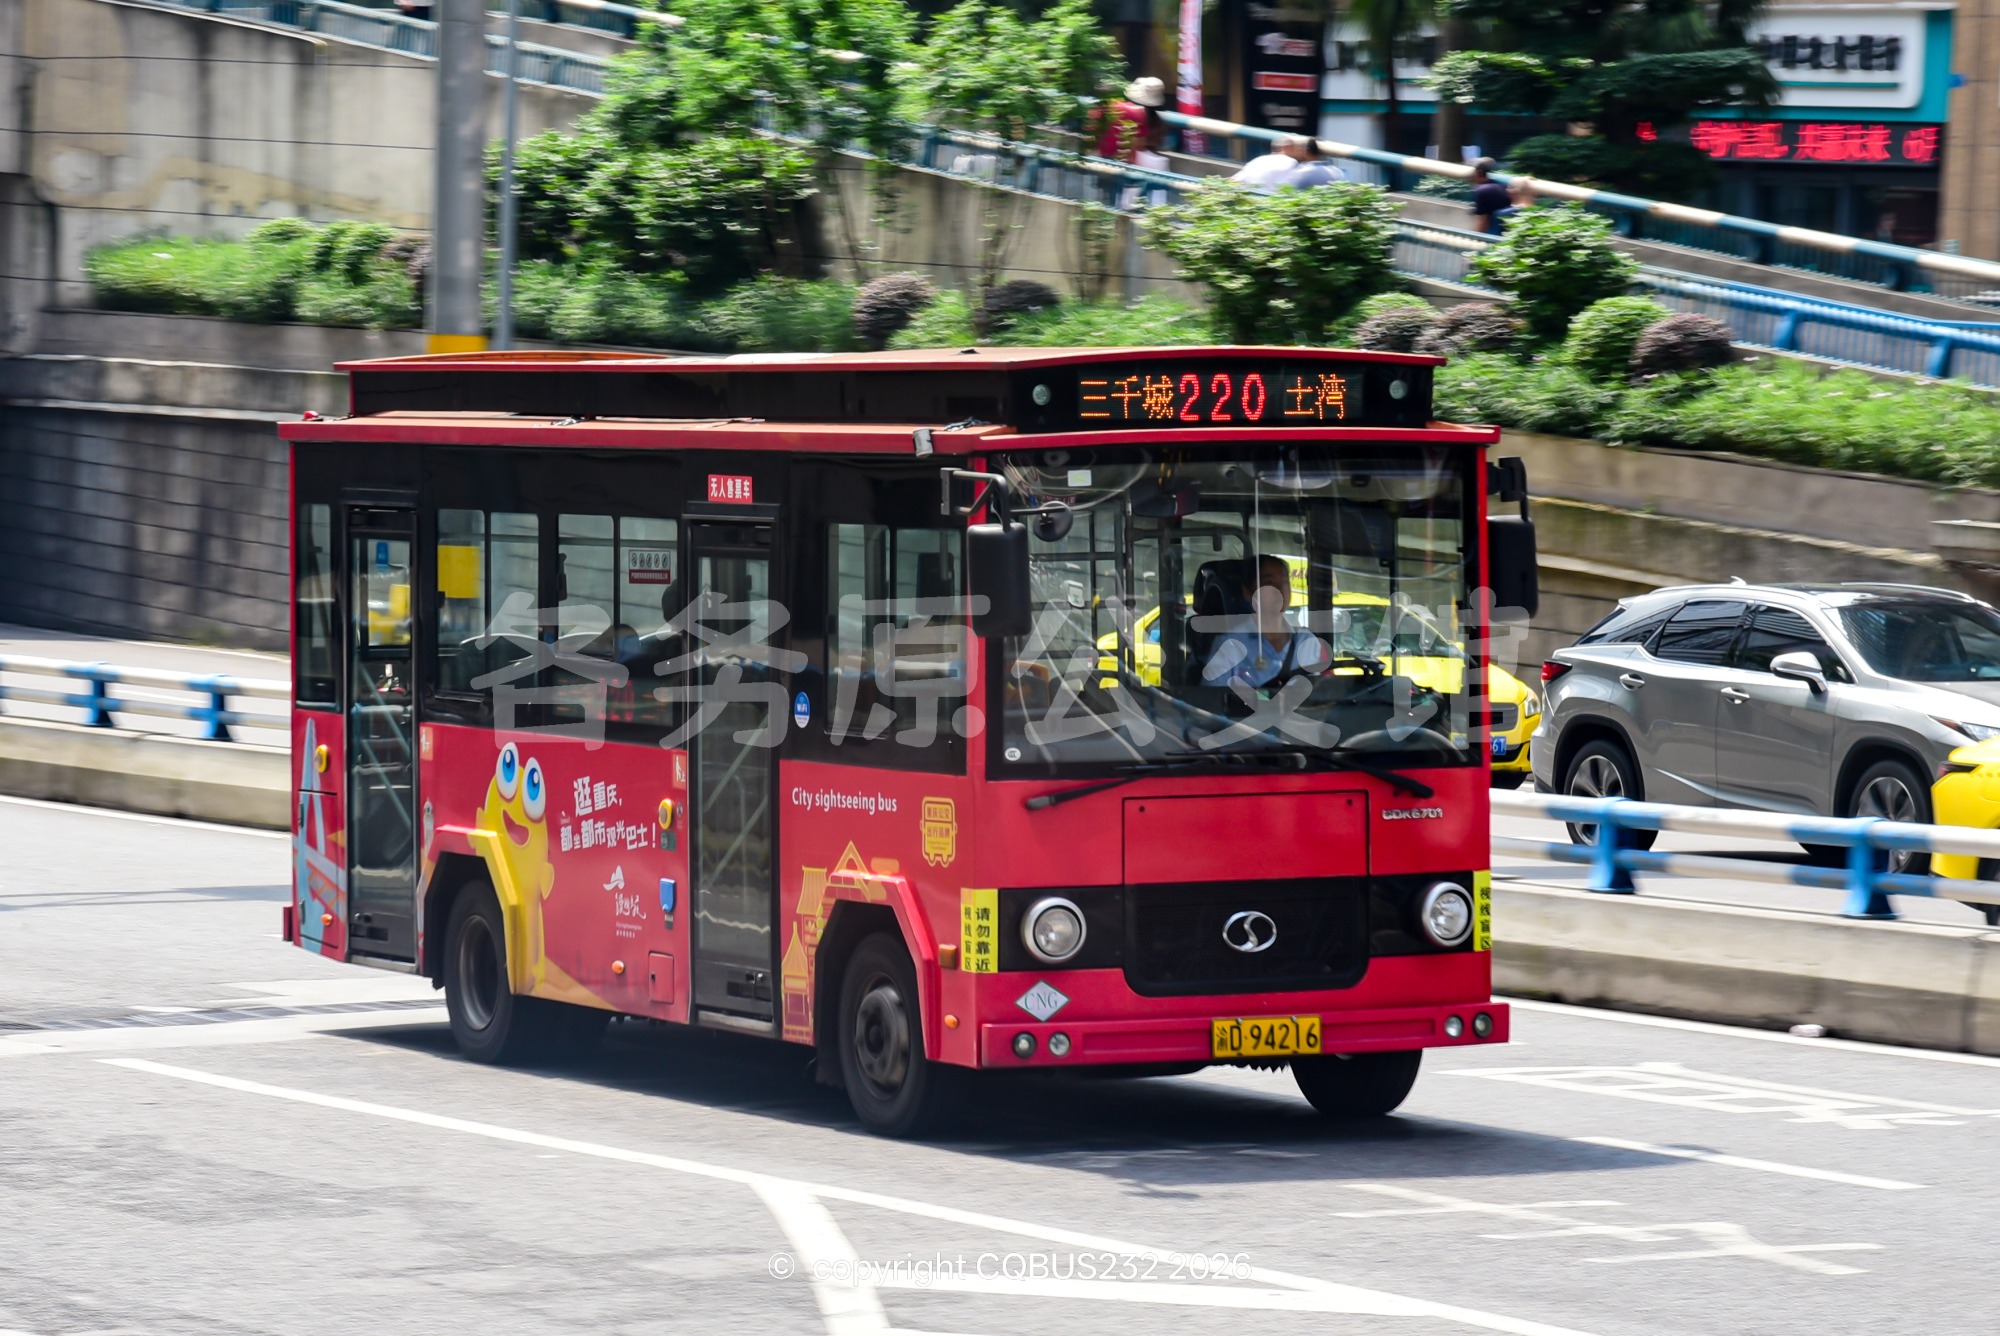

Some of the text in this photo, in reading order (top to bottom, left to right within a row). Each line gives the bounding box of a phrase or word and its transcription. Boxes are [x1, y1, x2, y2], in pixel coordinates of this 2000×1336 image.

[1080, 373, 1347, 421] 三千城 220 土湾
[710, 477, 751, 499] 无人售票车
[792, 786, 898, 815] City sightseeing bus
[975, 907, 991, 972] 请勿靠近
[1024, 991, 1058, 1011] CNG
